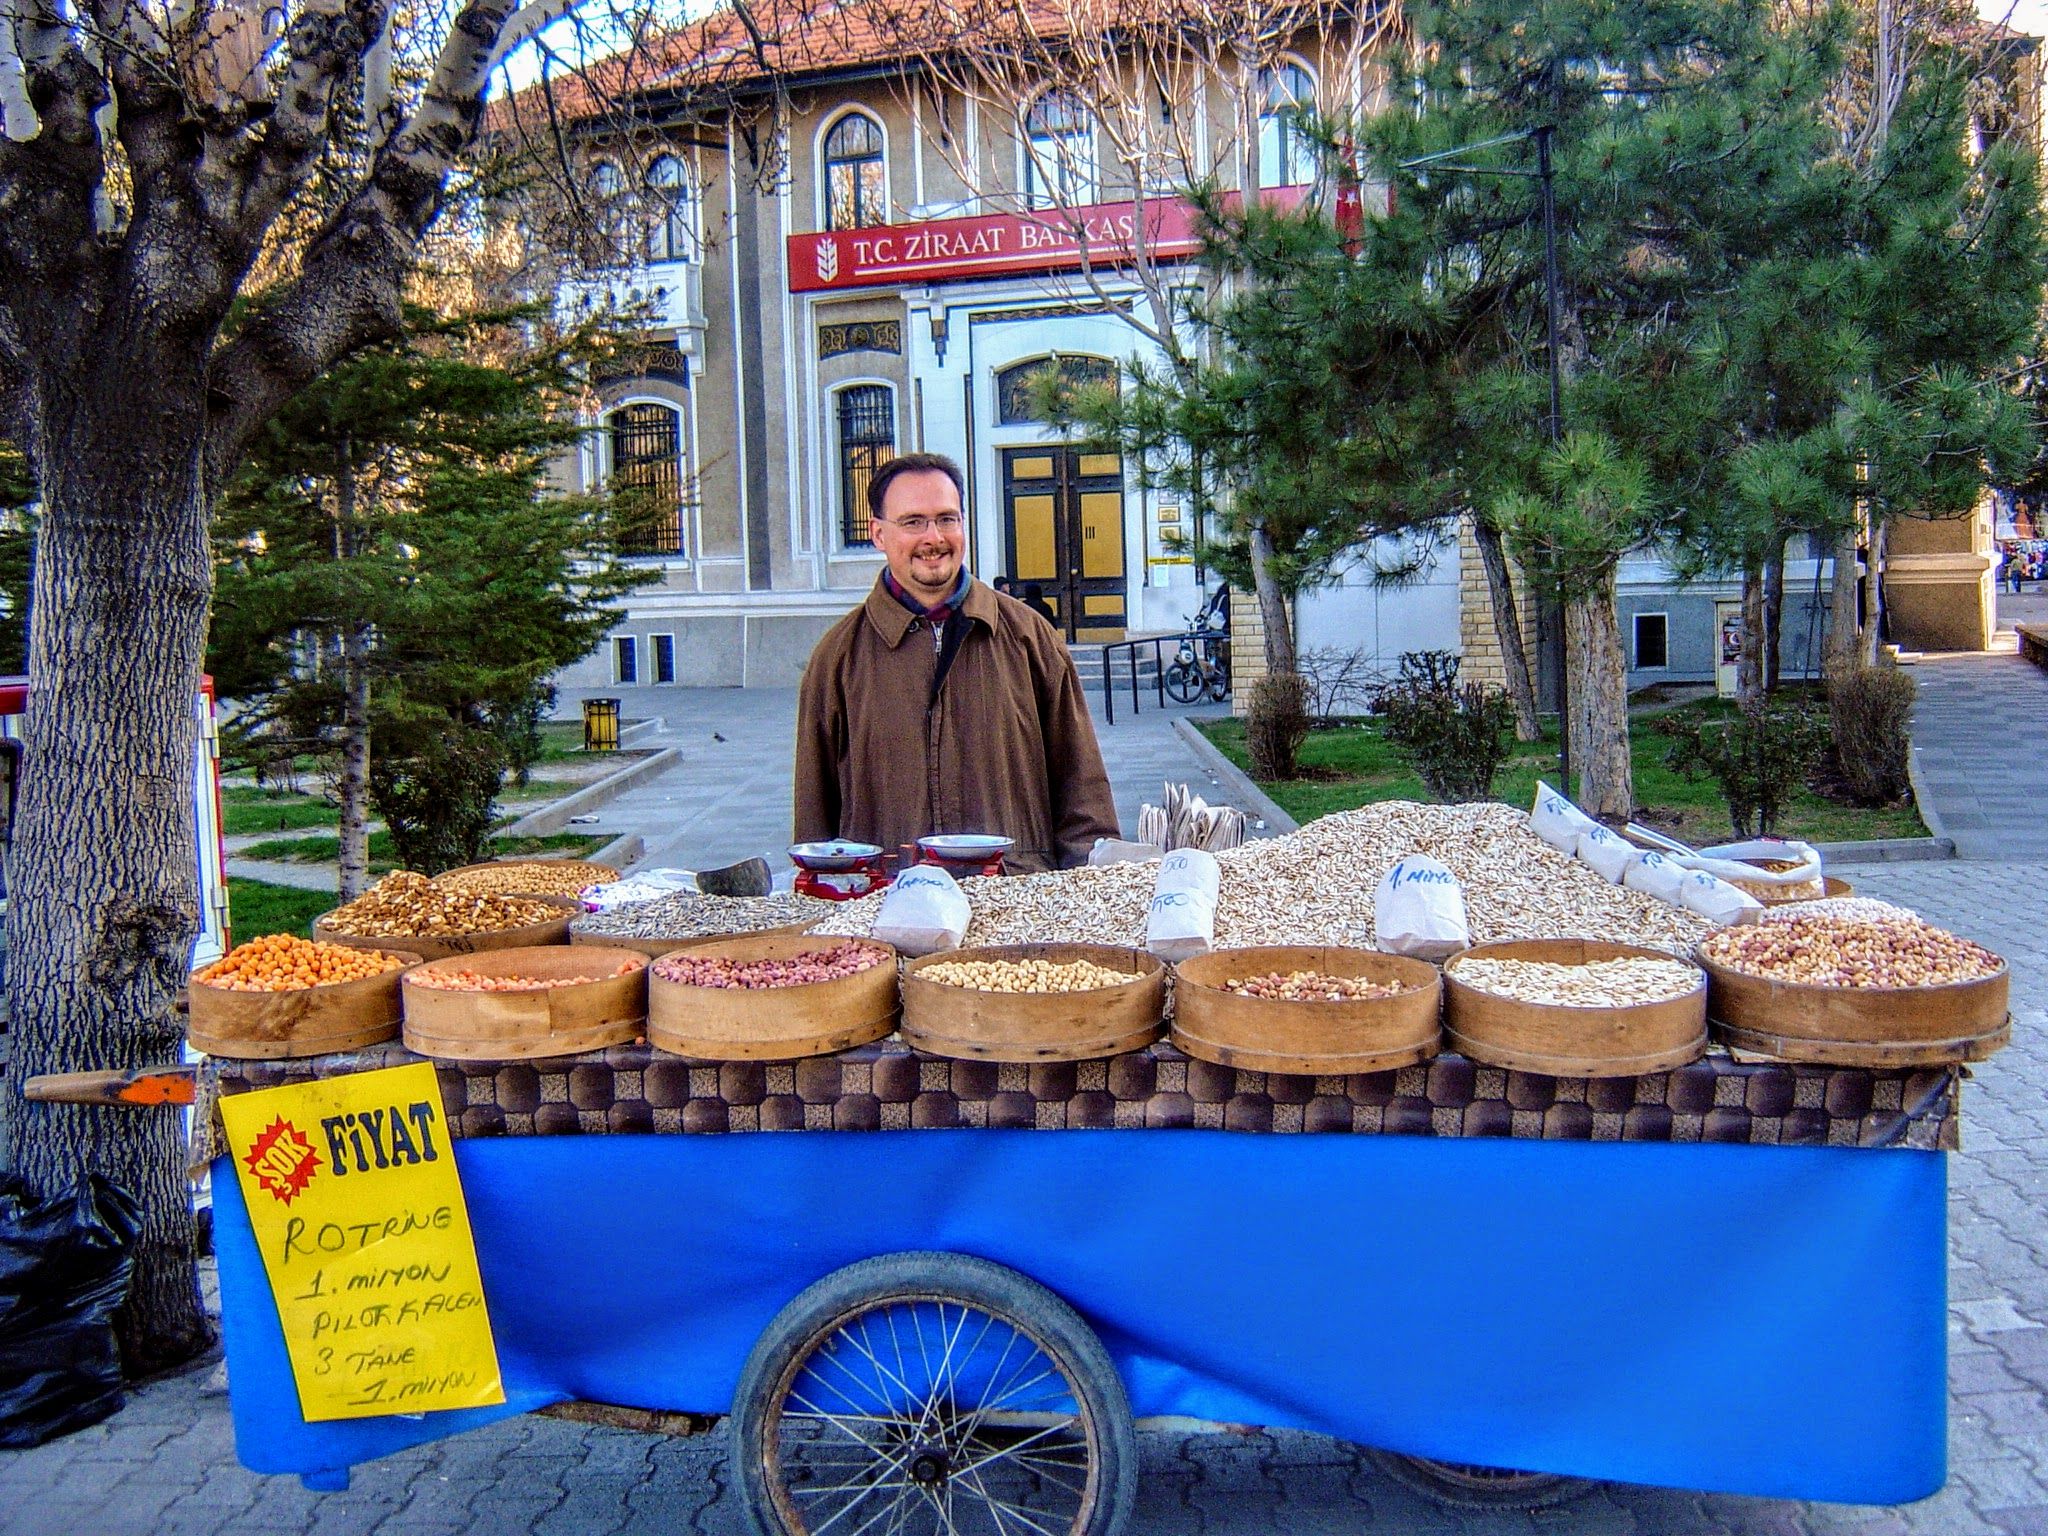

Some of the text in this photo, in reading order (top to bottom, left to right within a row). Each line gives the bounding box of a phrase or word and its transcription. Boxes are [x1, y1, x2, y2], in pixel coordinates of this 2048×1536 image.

[853, 214, 1142, 265] T.C. ZİRAAT BANKAS
[254, 1128, 311, 1195] ŞOK
[314, 1347, 334, 1376] 3
